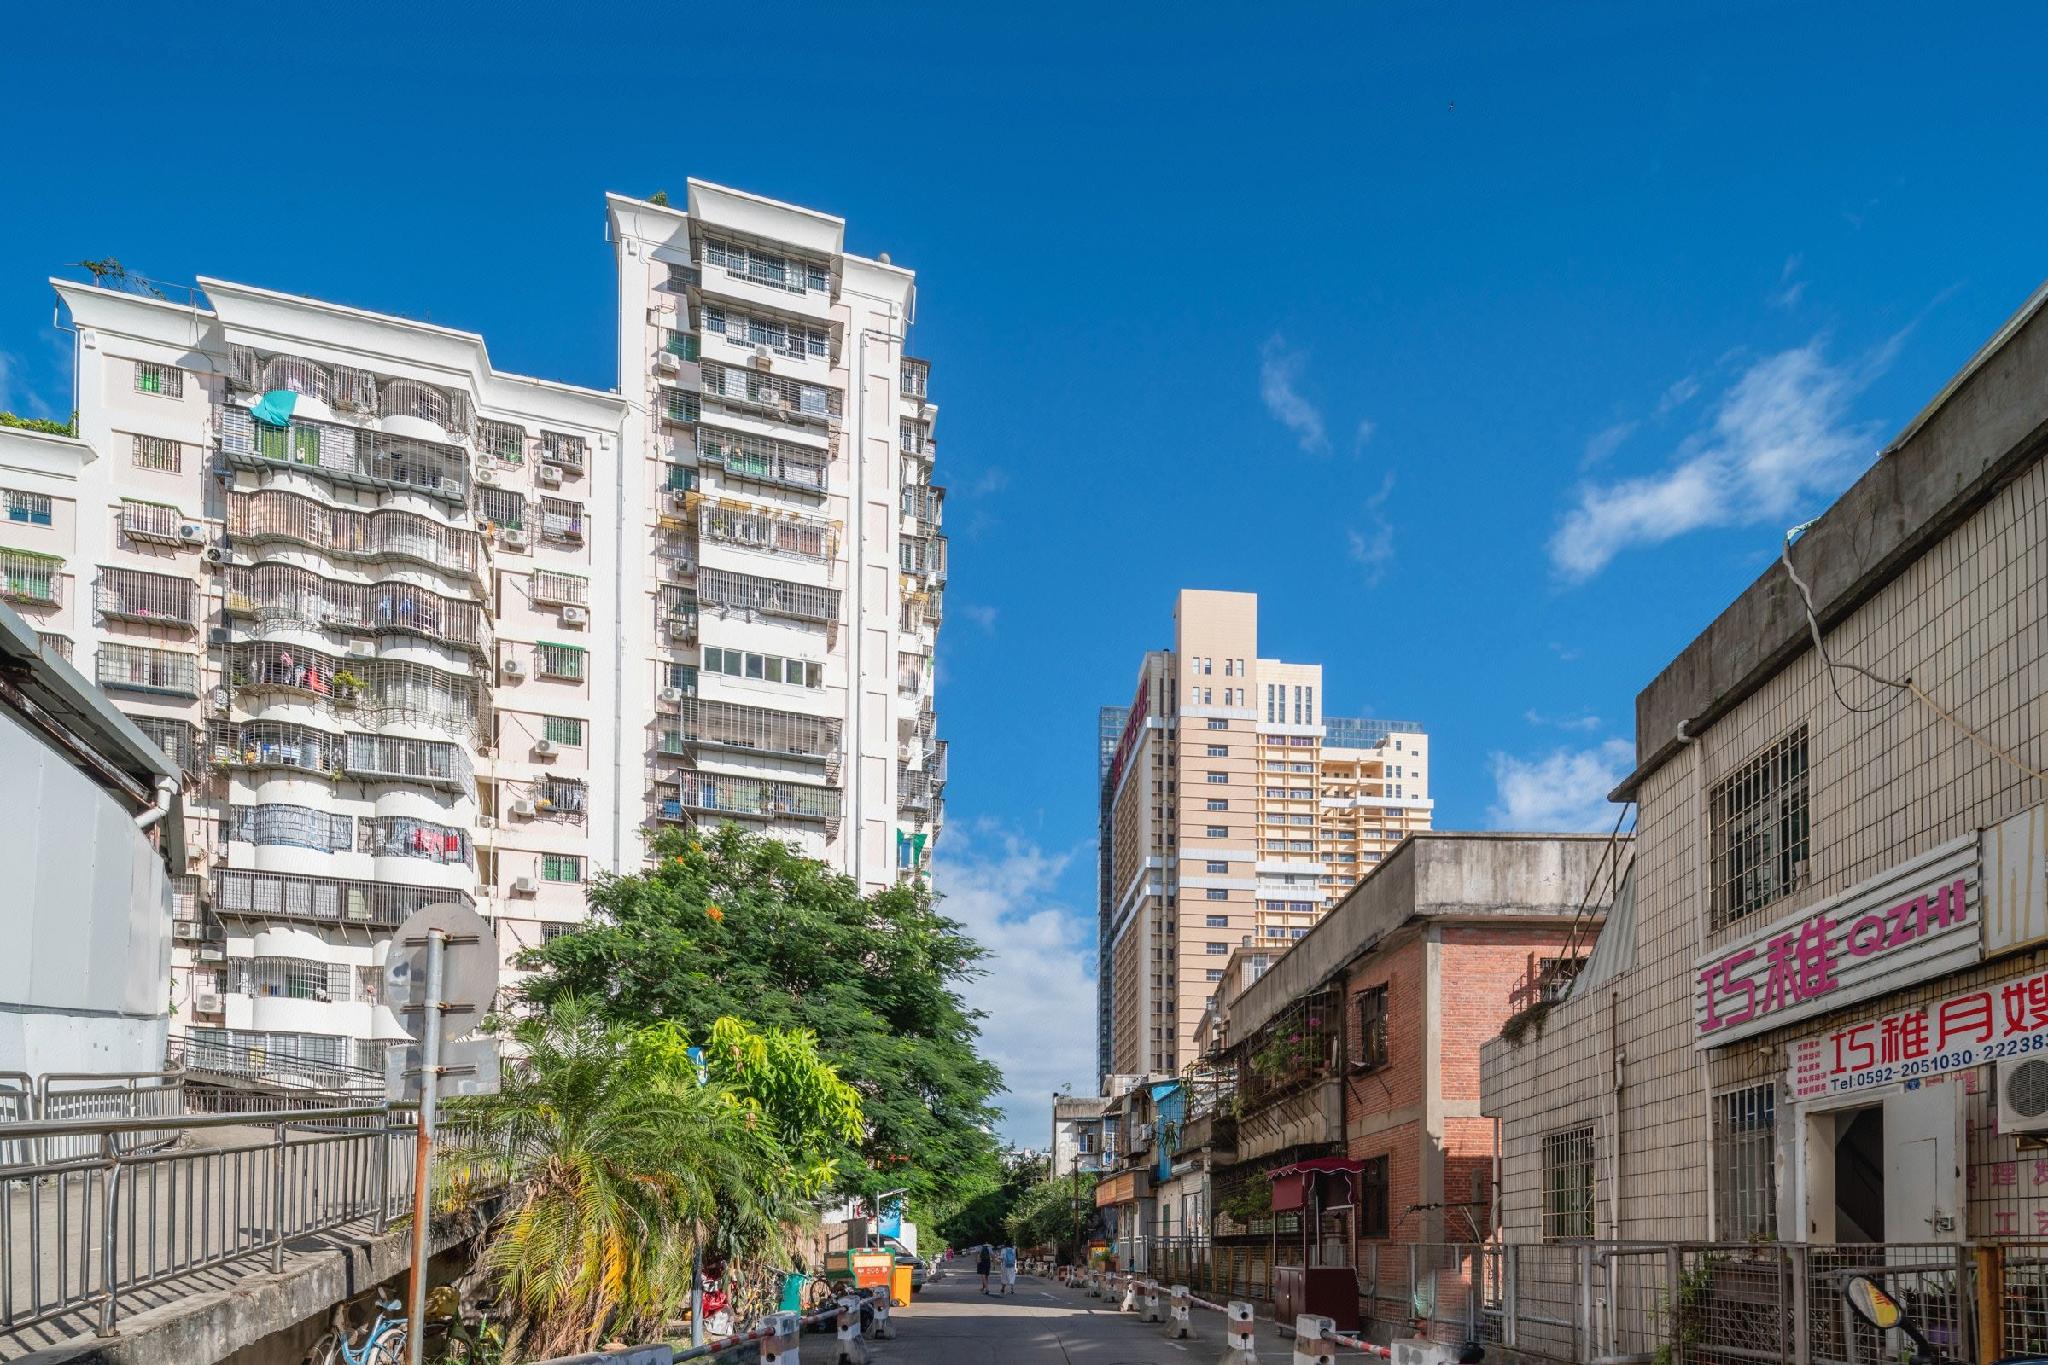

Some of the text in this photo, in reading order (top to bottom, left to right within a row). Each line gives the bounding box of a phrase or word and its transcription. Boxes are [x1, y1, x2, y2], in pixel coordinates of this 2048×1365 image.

[1700, 878, 1966, 1033] 巧稚 QZHI
[1830, 973, 2048, 1075] 巧稚月嫂
